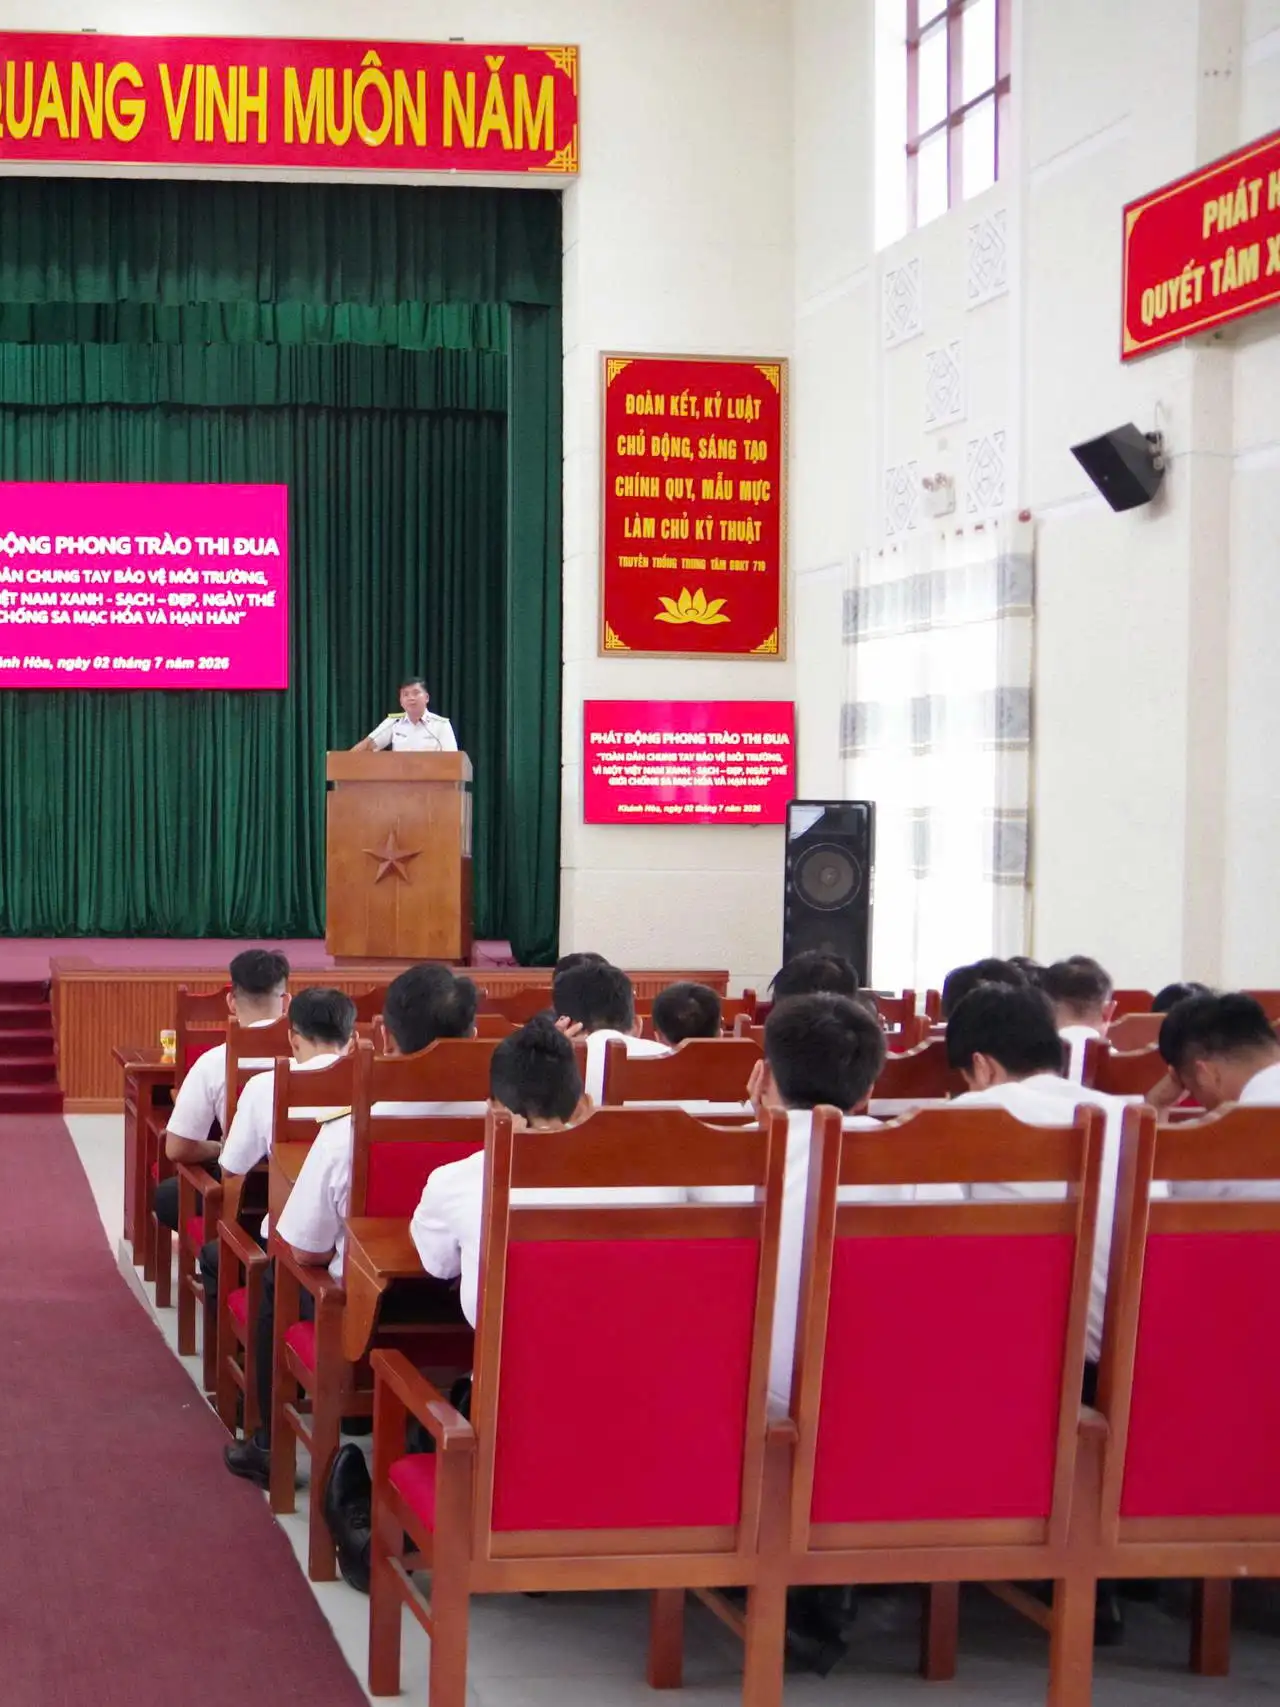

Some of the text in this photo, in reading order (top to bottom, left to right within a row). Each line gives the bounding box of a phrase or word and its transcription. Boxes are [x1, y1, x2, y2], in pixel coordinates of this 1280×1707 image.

[159, 63, 268, 143] VINH
[284, 50, 426, 147] MUÔN
[443, 55, 555, 151] NĂM
[1202, 177, 1263, 239] PHÁT
[1141, 258, 1206, 327] QUYẾT
[1210, 244, 1260, 297] TÂM
[625, 388, 762, 423] ĐOÀN KẾT, KỶ LUẬT
[617, 428, 768, 464] CHỦ ĐỘNG, SÁNG TẠO
[615, 472, 770, 506] CHÍNH QUY, MẪU MỰC
[55, 536, 132, 555] PHONG
[134, 532, 192, 555] TRÀO
[194, 537, 230, 556] THI
[233, 537, 280, 556] ĐUA
[624, 512, 762, 544] LÀM CHỦ KỸ THUẬT
[26, 570, 80, 583] CHUNG
[83, 570, 112, 584] TAY
[114, 567, 146, 584] BẢO
[148, 568, 167, 586] VỆ
[169, 568, 200, 584] MÔI
[202, 568, 268, 586] TRƯỜNG,
[20, 592, 58, 606] NAM
[60, 592, 104, 606] XANH
[116, 592, 155, 608] SẠCH
[168, 592, 200, 608] ĐẸP,
[202, 590, 245, 607] NGÀY
[246, 590, 276, 608] THẾ
[50, 610, 71, 624] SA
[73, 610, 108, 626] MẠC
[146, 608, 168, 624] VÀ
[170, 611, 203, 627] HẠN
[154, 656, 162, 669] 7
